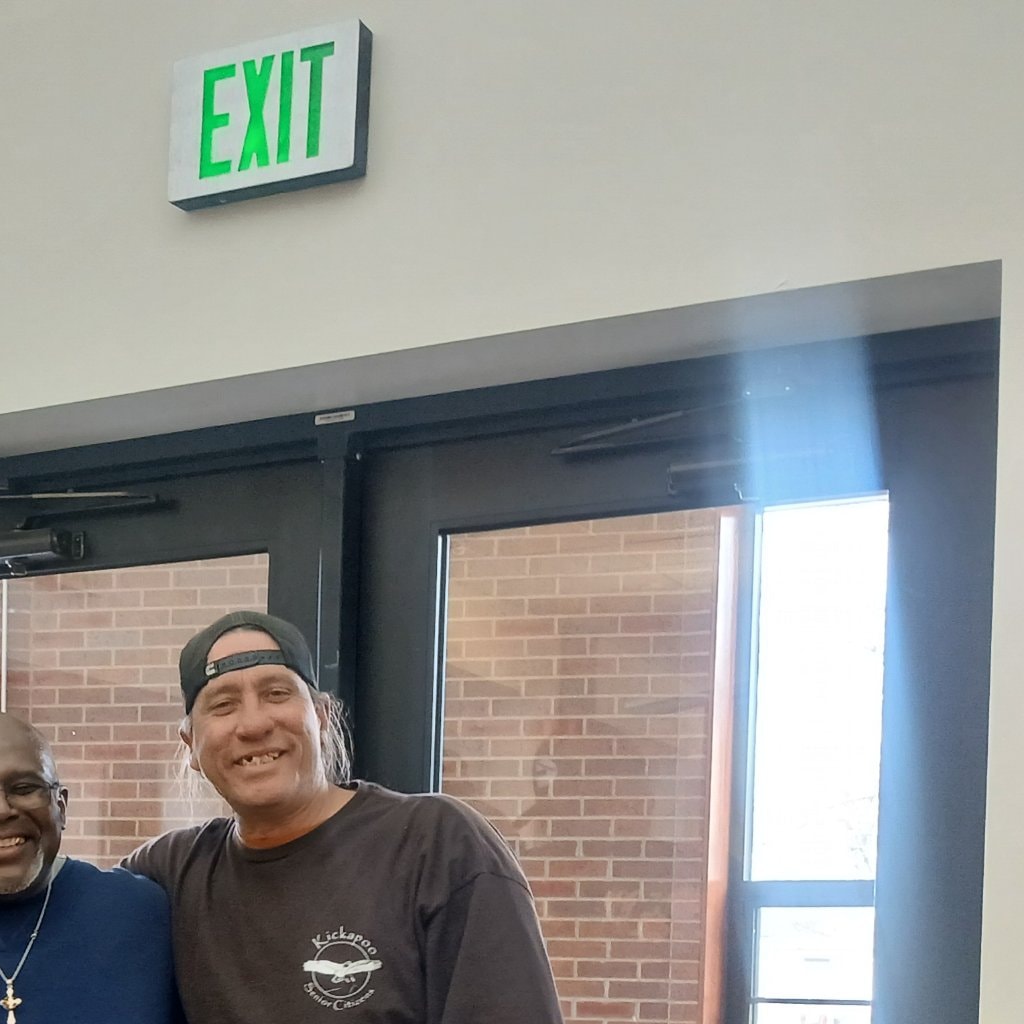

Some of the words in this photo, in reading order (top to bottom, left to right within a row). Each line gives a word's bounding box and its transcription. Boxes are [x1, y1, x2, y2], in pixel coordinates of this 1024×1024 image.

[199, 41, 335, 179] EXIT
[311, 925, 377, 955] Kickapoo
[303, 982, 333, 1008] Senior
